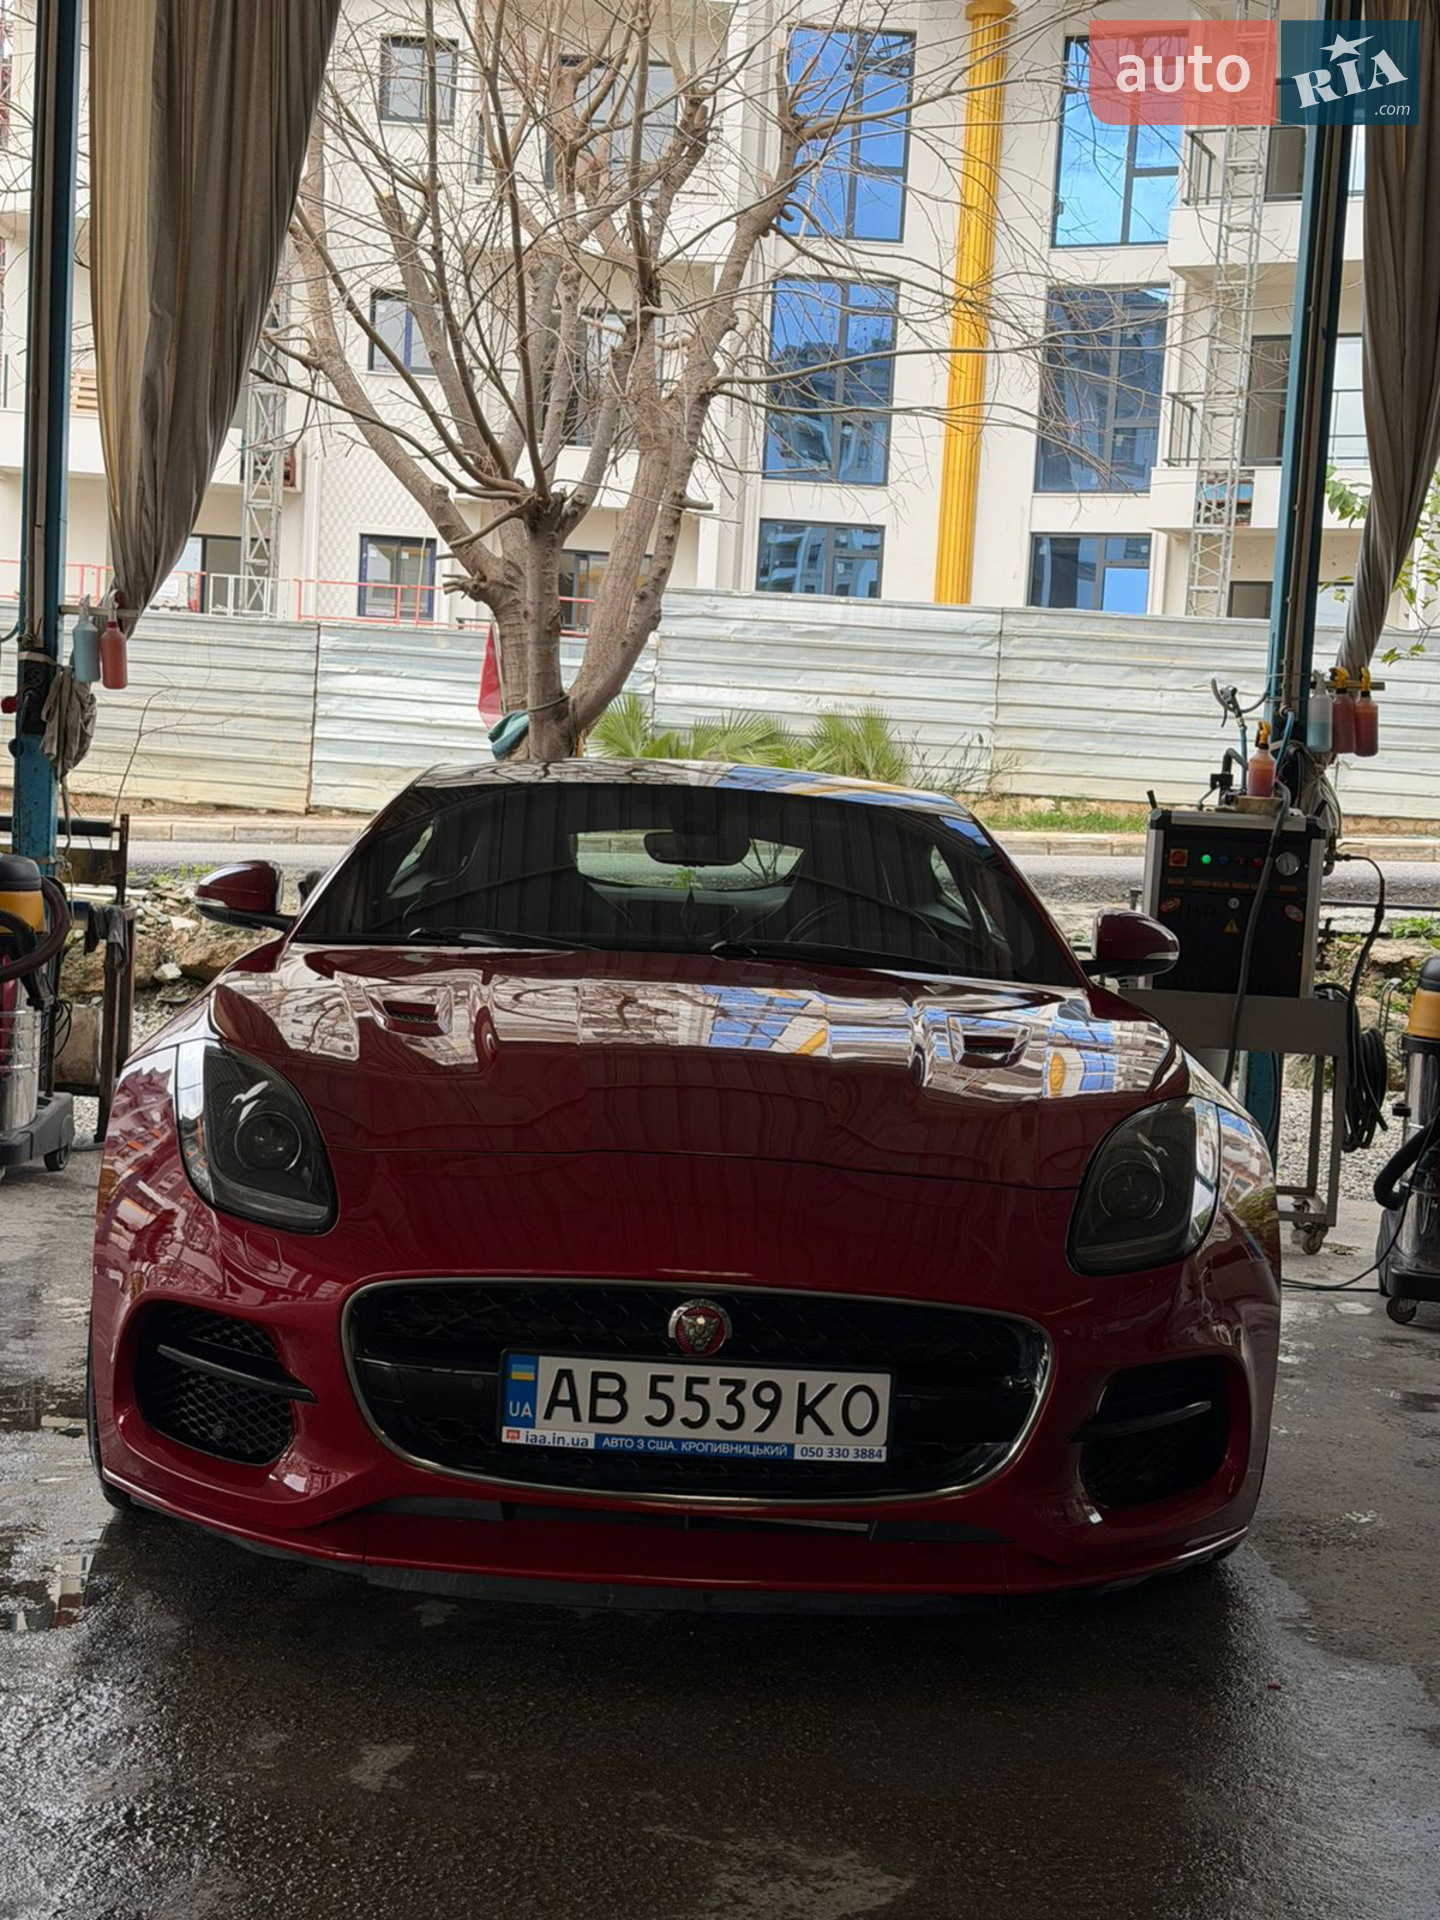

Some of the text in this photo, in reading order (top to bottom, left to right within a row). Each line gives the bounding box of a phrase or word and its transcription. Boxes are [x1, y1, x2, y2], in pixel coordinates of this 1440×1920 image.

[509, 1401, 533, 1419] UA
[543, 1367, 880, 1437] AB 5539 KO
[525, 1430, 589, 1448] iaa.in.ua
[602, 1437, 635, 1449] АВТО
[681, 1441, 788, 1457] КРОПИВНИЦЬКИЙ
[800, 1446, 883, 1460] 050 330 3884
